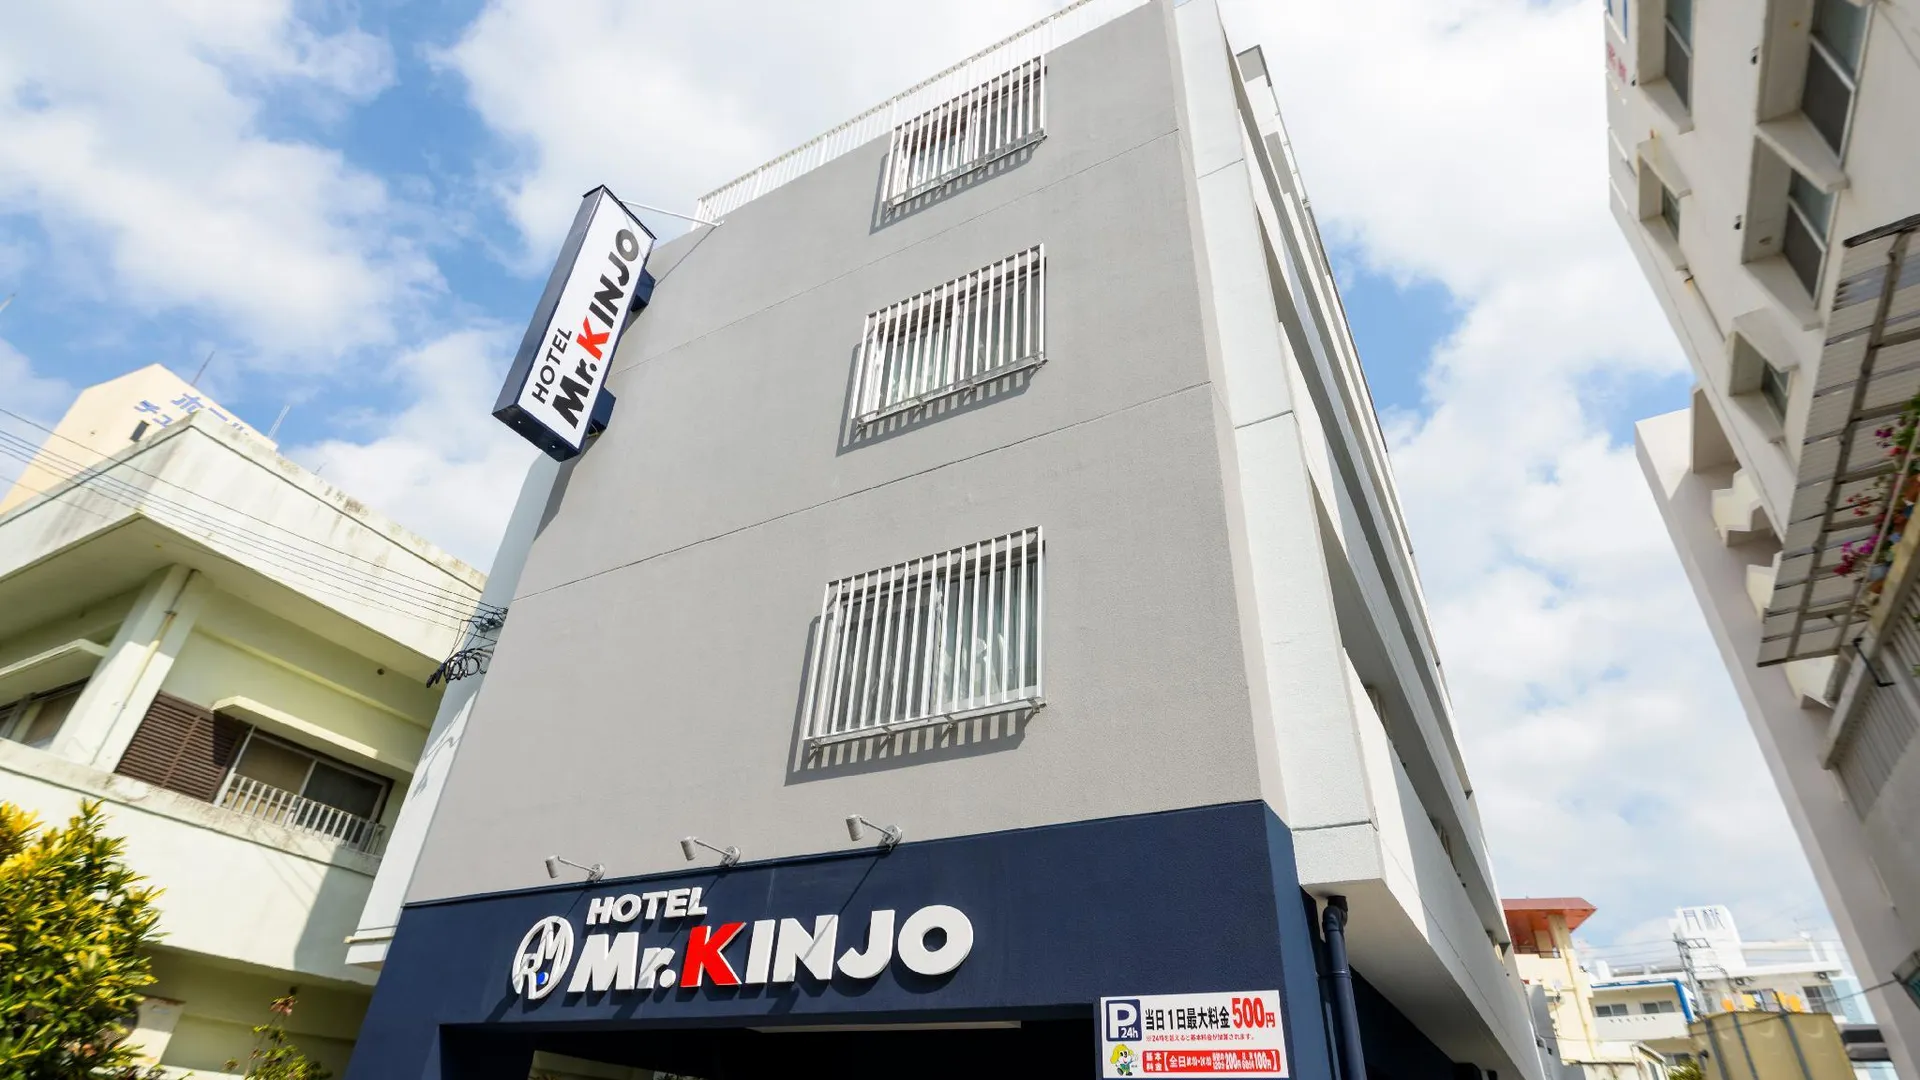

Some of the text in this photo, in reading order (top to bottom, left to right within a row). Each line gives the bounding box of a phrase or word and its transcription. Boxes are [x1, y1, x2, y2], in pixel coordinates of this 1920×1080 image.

[532, 328, 572, 404] HOTEL
[587, 887, 708, 924] HOTEL
[1109, 1003, 1137, 1038] P
[1121, 1027, 1139, 1039] 24h
